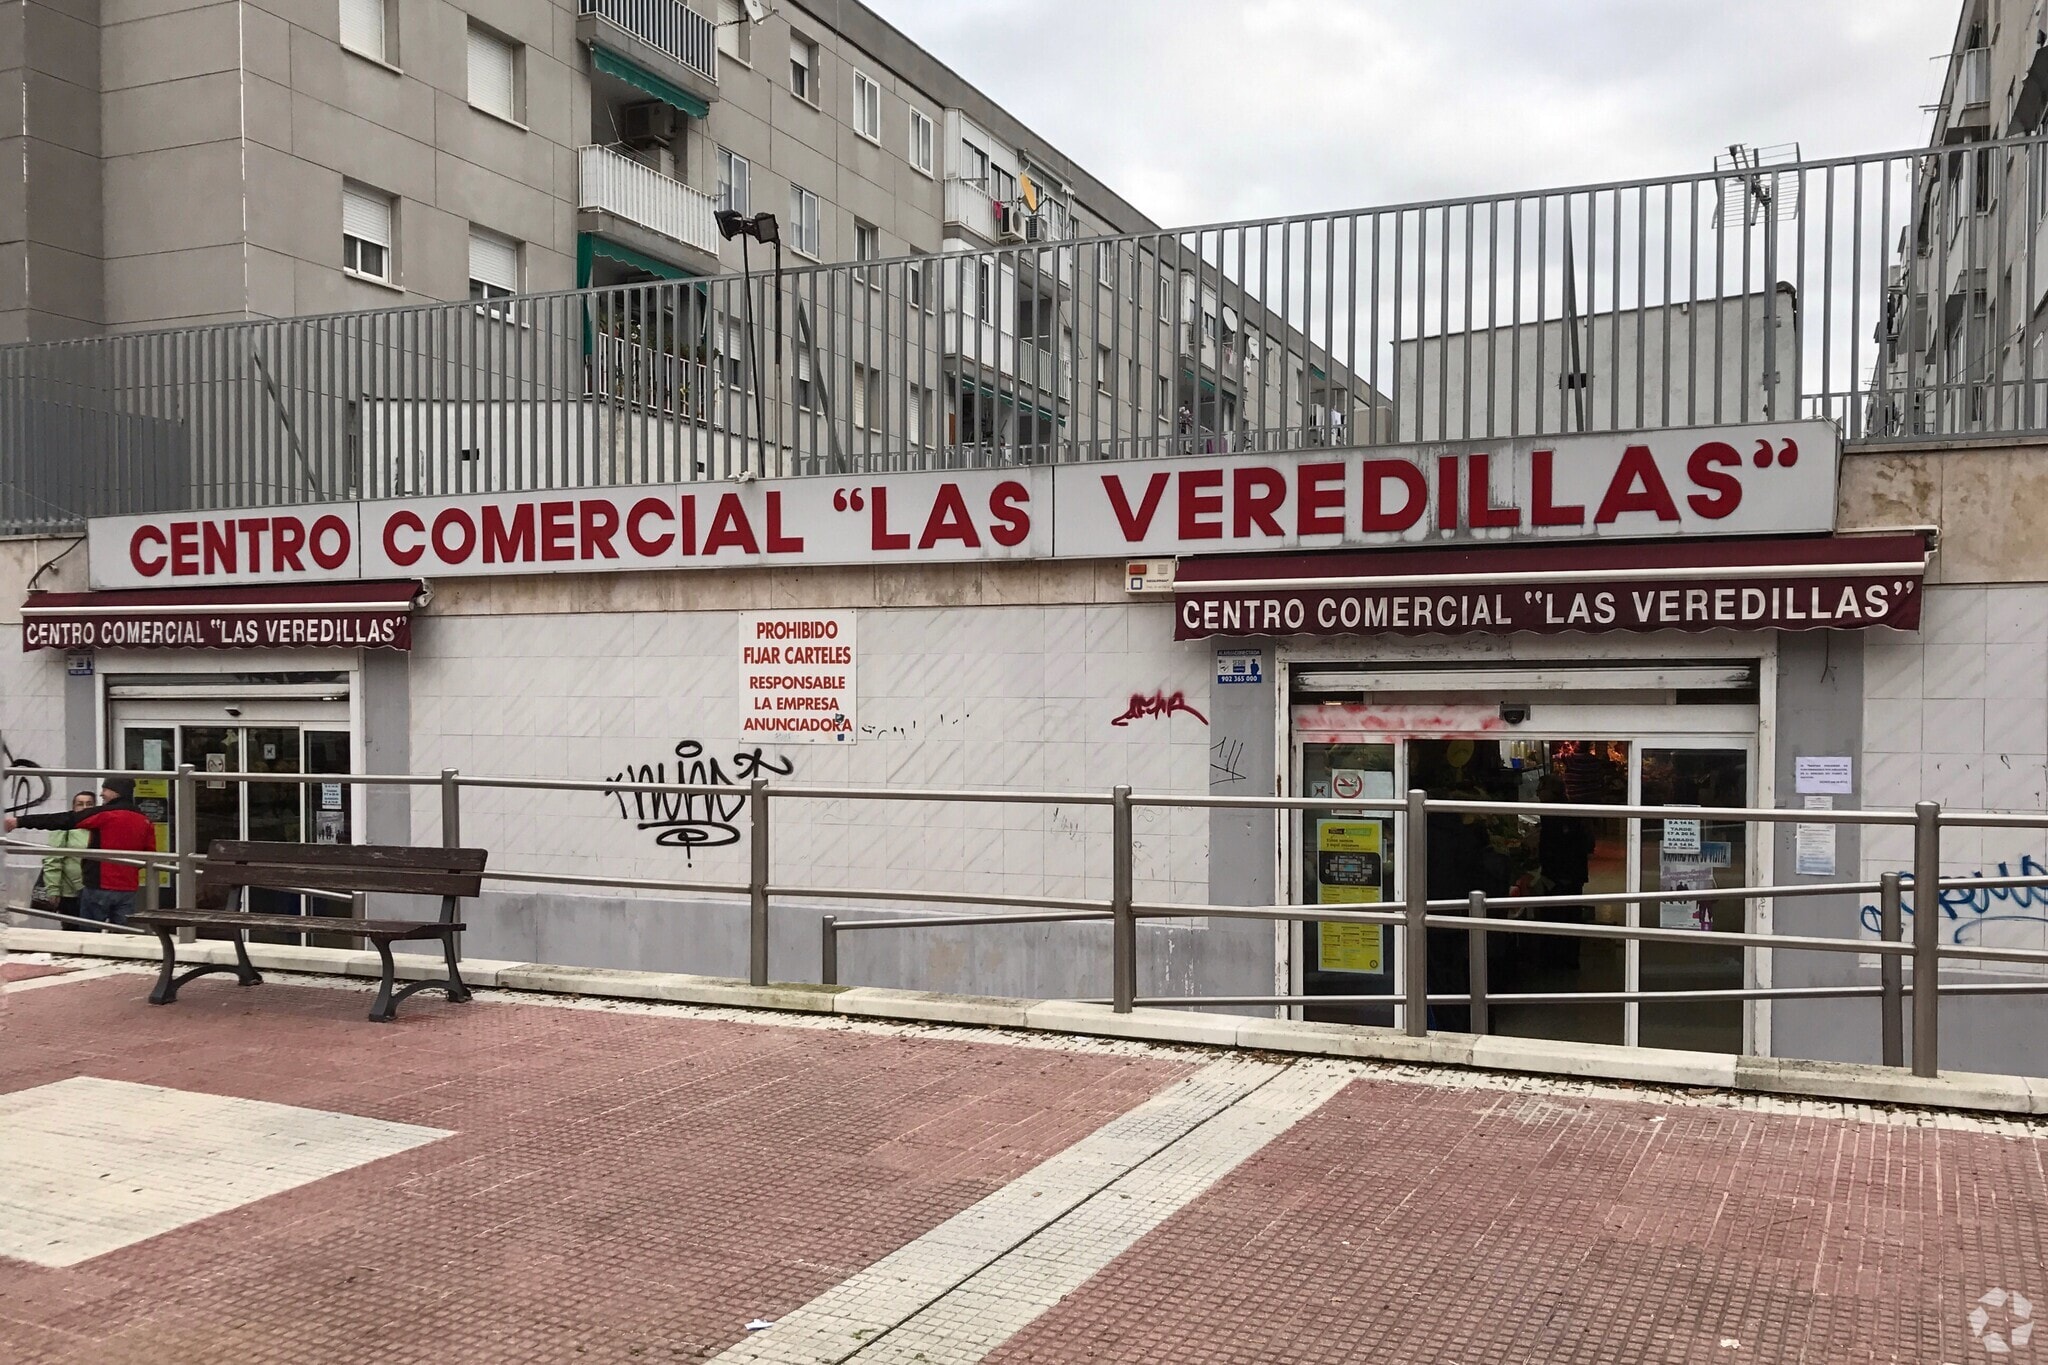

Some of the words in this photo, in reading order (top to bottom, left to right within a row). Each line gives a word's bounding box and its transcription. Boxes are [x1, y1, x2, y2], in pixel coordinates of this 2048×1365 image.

[129, 515, 351, 577] CENTRO
[383, 491, 804, 566] COMERCIAL
[833, 481, 1030, 551] "LAS
[1102, 437, 1798, 542] VEREDILLAS"
[1183, 598, 1304, 629] CENTRO
[1317, 594, 1511, 627] COMERCIAL
[1525, 590, 1616, 624] "LAS
[1632, 581, 1914, 623] VEREDILLAS"
[26, 622, 95, 645] CENTRO
[102, 620, 204, 644] COMERCIAL
[211, 618, 258, 643] "LAS
[266, 615, 408, 643] VEREDILLAS"
[756, 620, 839, 640] PROHIBIDO
[743, 646, 781, 665] FIJAR
[784, 646, 852, 665] CARTELES
[749, 675, 846, 690] RESPONSABLE
[754, 697, 772, 711] LA
[776, 696, 840, 712] EMPRESA
[743, 717, 853, 732] ANUNCIADORA
